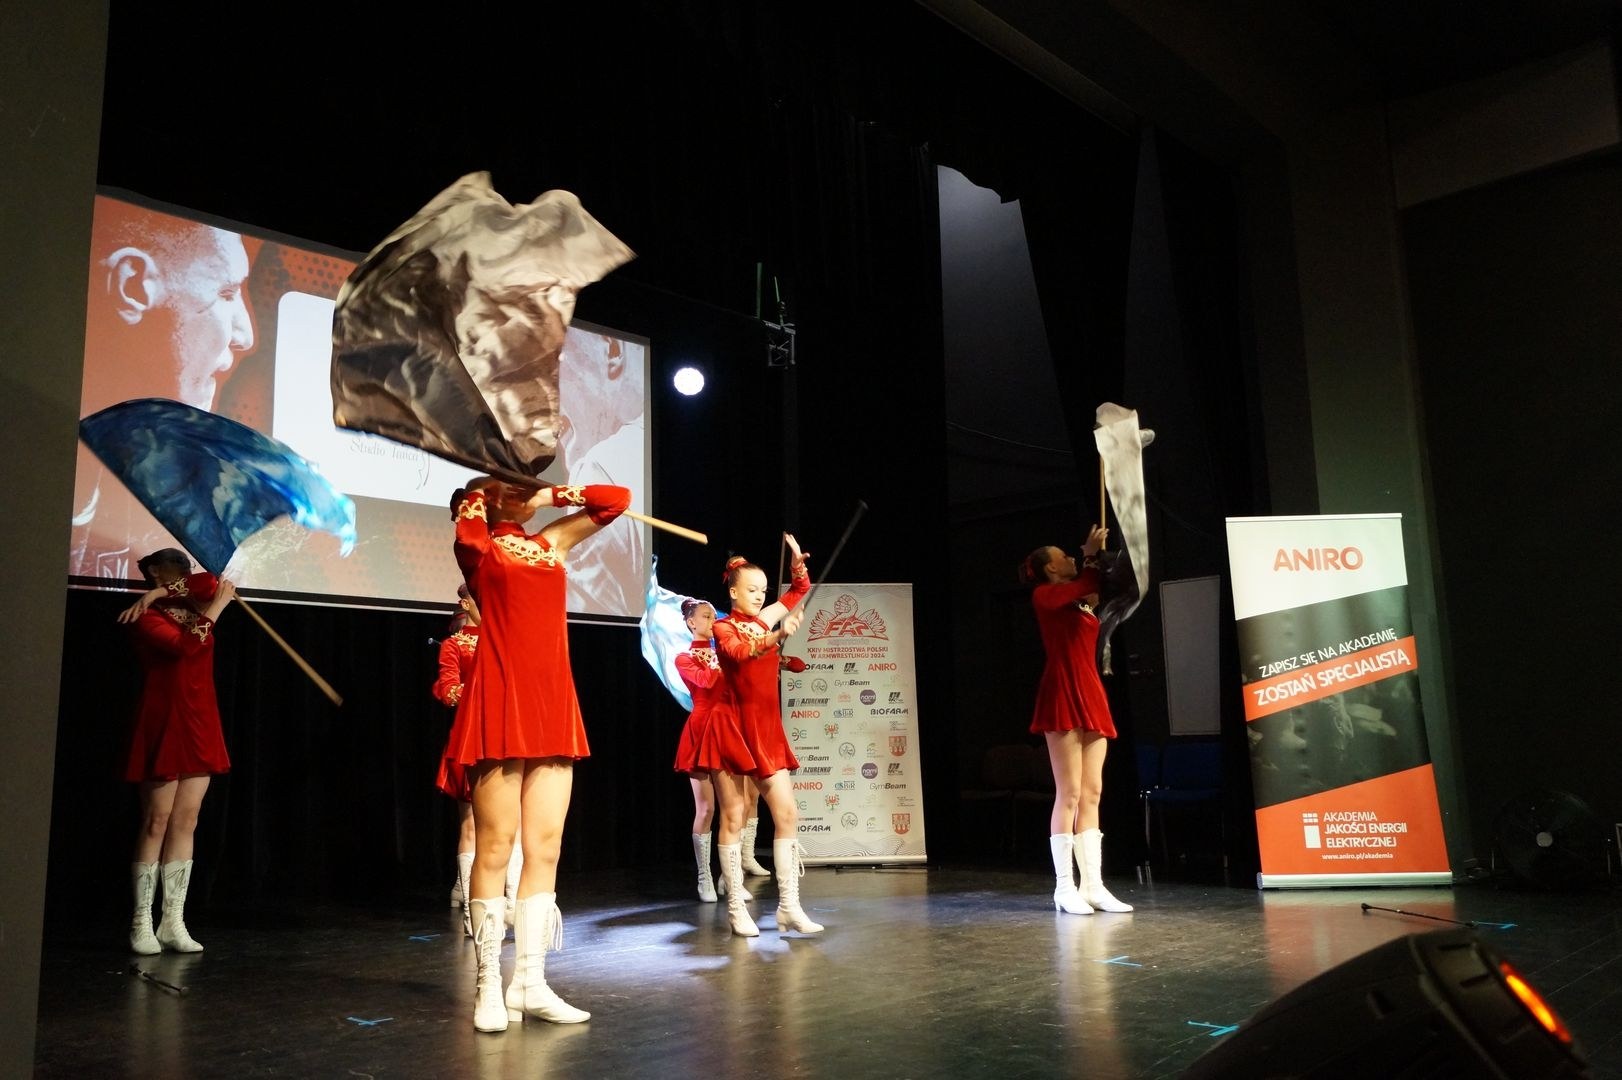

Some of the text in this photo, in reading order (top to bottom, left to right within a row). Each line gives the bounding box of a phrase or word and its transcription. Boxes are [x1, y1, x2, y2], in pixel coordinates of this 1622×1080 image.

[350, 438, 386, 457] Studio
[1273, 546, 1364, 572] ANIRO
[1259, 628, 1398, 678] ZAPISZ SIĘ NA AKADEMIĘ
[868, 663, 897, 671] ANIRO
[1254, 648, 1412, 706] ZOSTAŃ SPECJALISTĄ
[791, 711, 820, 719] ANIRO
[793, 782, 823, 790] ANIRO
[1323, 811, 1377, 822] AKADEMIA
[1325, 822, 1408, 834] JAKOŚCI ENERGII
[1326, 837, 1397, 848] ELEKTRYCZNEJ
[1321, 853, 1393, 861] www.aniro.pl/akademia
